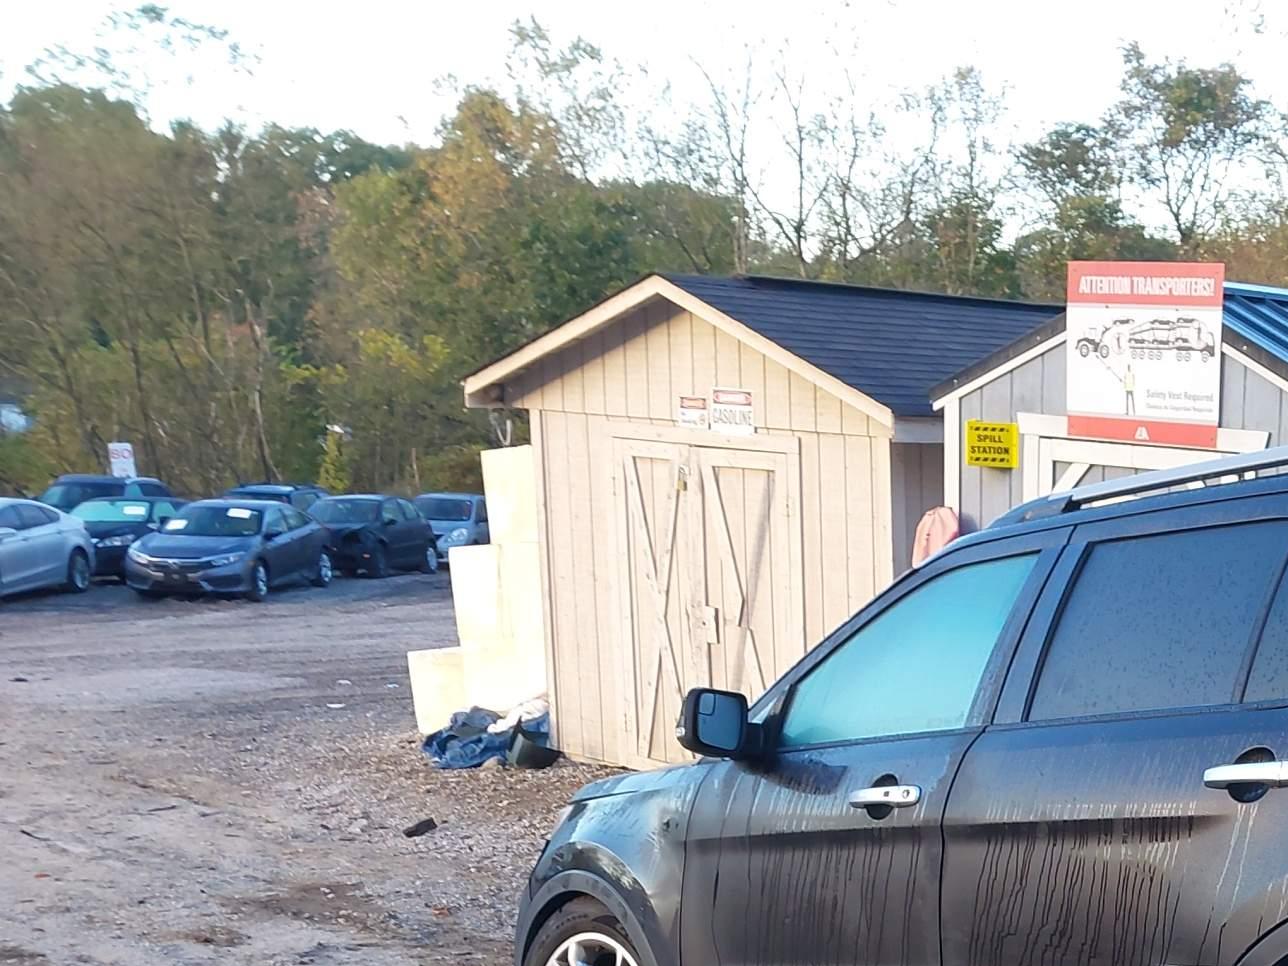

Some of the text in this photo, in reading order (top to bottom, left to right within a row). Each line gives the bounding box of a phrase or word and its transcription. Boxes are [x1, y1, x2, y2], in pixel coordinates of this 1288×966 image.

[1079, 275, 1215, 297] ATTENTION TRANSPORTERS!
[976, 434, 1004, 443] SPILL
[970, 445, 1010, 455] STATION
